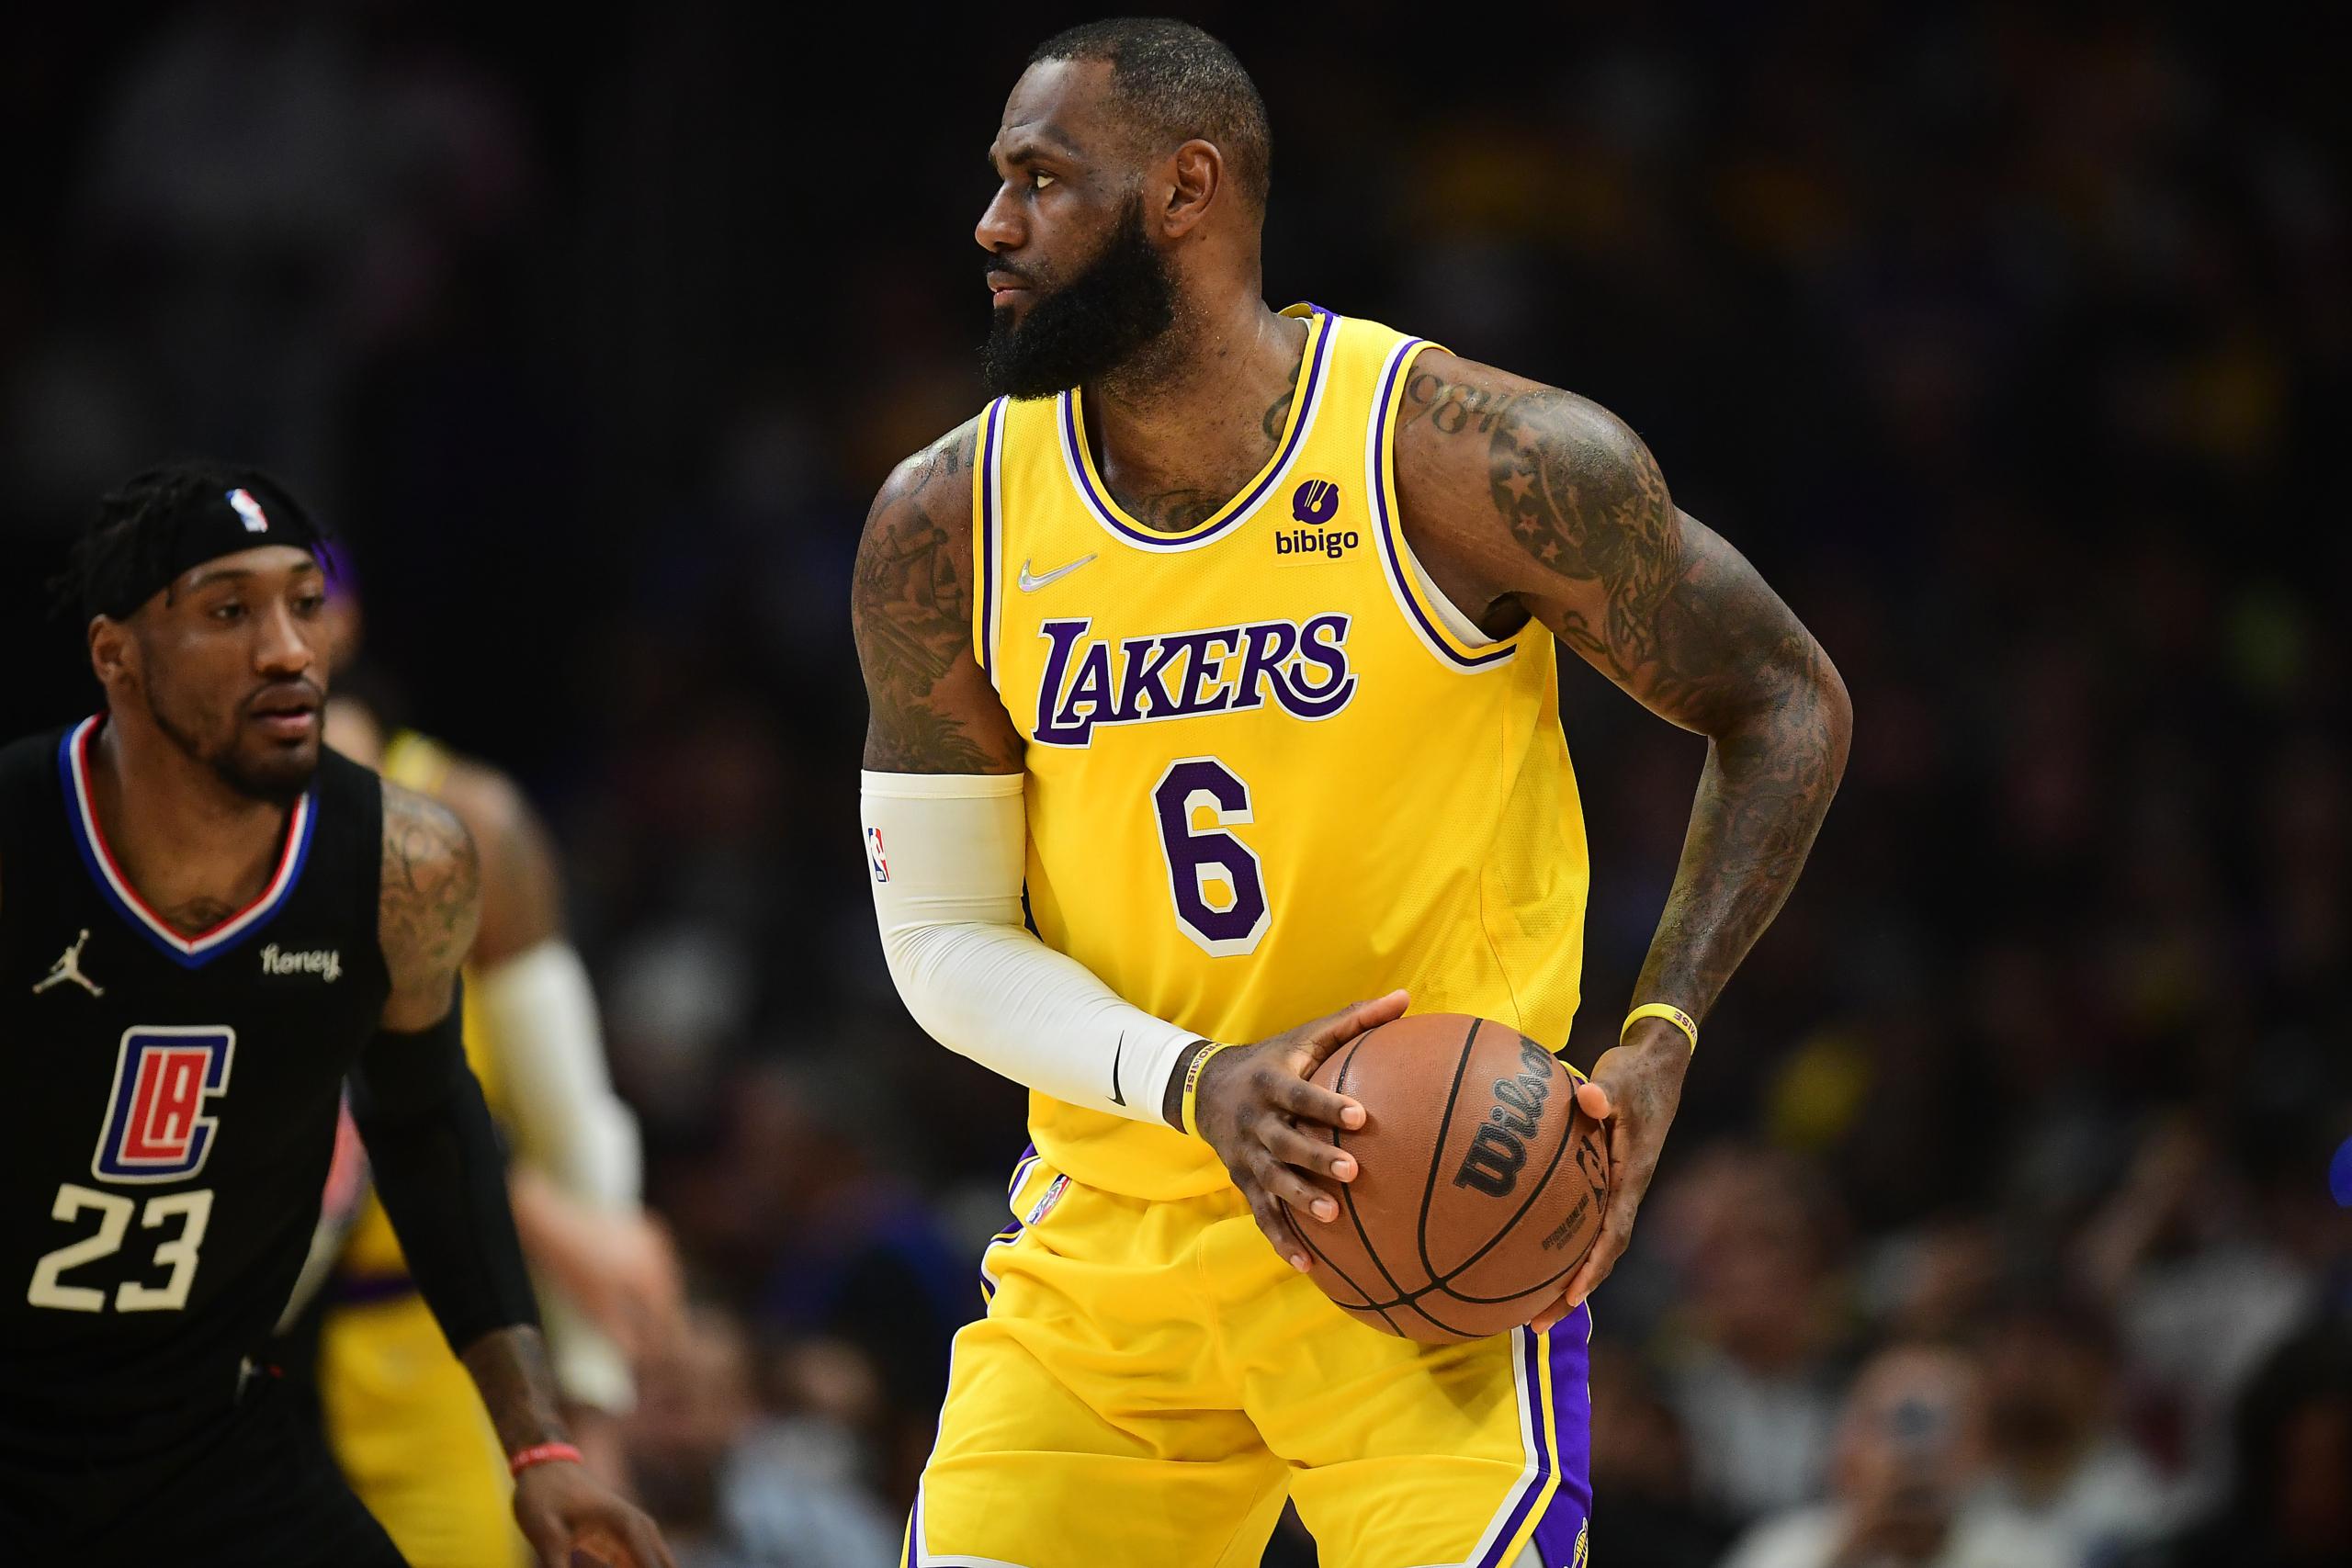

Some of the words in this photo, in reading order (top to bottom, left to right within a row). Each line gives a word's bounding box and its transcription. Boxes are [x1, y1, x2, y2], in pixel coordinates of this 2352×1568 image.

[1275, 528, 1359, 558] bibigo
[1033, 612, 1360, 749] LAKERS
[1150, 755, 1272, 958] 6
[260, 942, 343, 984] honey
[28, 1183, 213, 1313] 23
